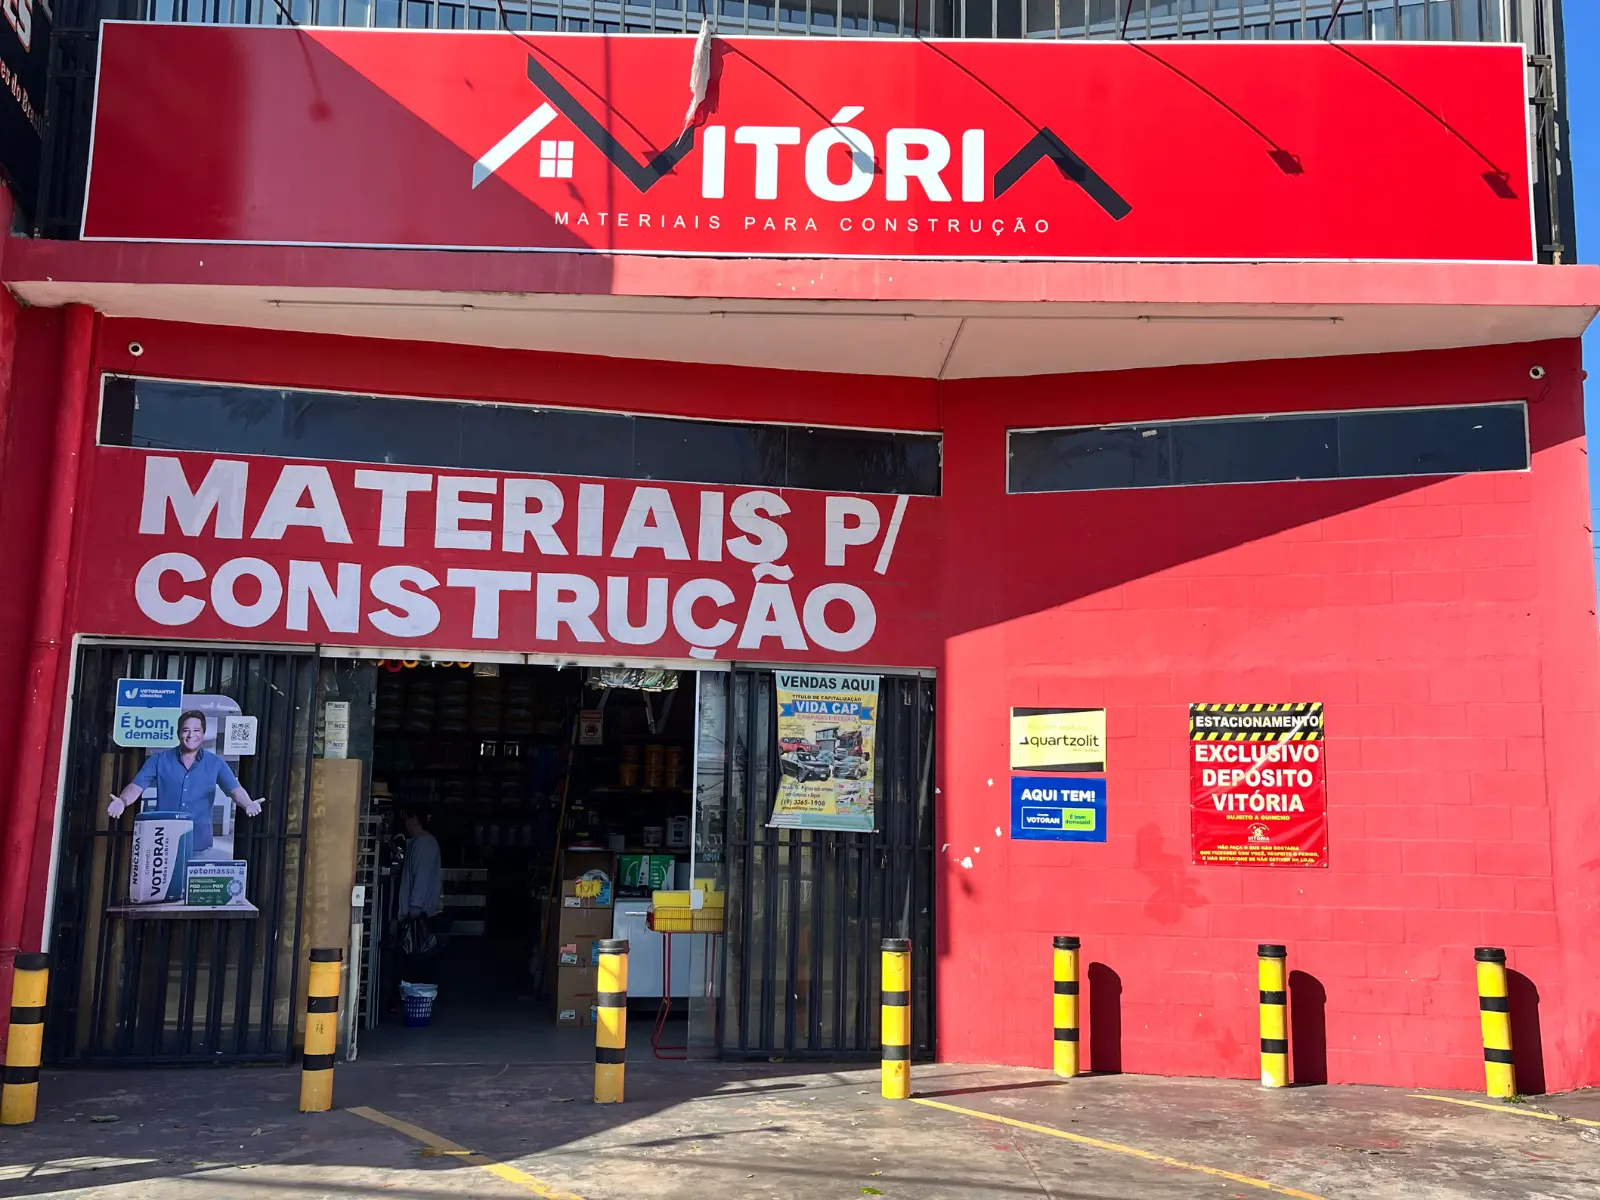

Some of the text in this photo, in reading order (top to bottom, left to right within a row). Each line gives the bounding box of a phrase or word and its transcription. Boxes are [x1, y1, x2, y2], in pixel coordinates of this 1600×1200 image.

[11, 72, 21, 102] do
[554, 212, 1050, 236] MATERIAIS PARA CONSTRUÇÃO
[137, 455, 910, 575] MATERIAIS P/
[134, 551, 877, 661] CONSTRUÇÃO
[781, 675, 875, 691] VENDAS AQUI
[796, 701, 859, 715] VIDA CAP
[120, 712, 170, 729] É bom
[1195, 715, 1319, 728] ESTACIONAMENTO
[125, 726, 174, 740] demais!
[1030, 735, 1100, 748] quartzolit
[1195, 744, 1320, 763] EXCLUSIVO
[1202, 766, 1313, 787] DEPÓSITO
[1021, 788, 1096, 802] AQUI TEM!
[1212, 790, 1305, 812] VITÓRIA
[151, 827, 165, 897] VOTORAN
[189, 867, 235, 875] votomassa
